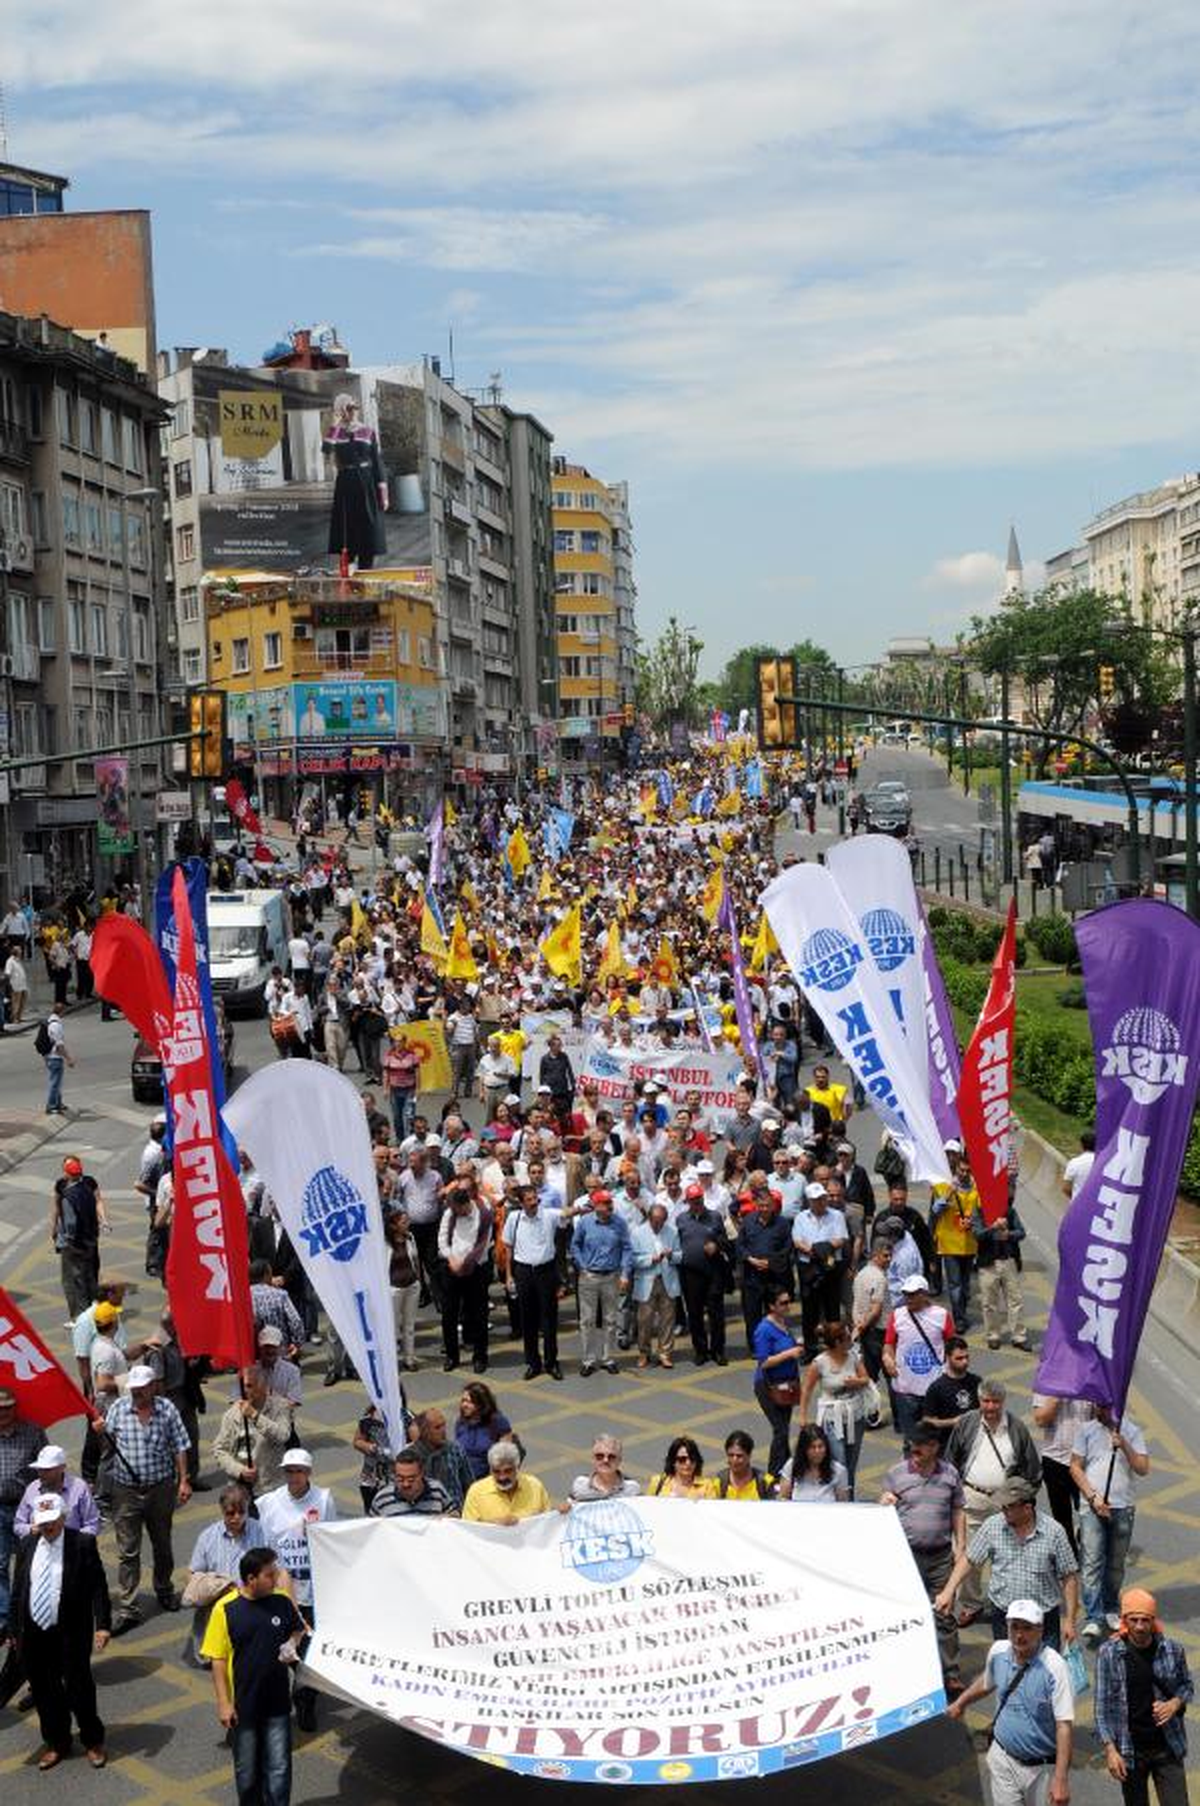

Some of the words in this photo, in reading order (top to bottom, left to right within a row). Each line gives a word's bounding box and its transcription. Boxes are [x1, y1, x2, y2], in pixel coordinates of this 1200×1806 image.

[223, 401, 278, 421] SRM
[560, 1529, 656, 1569] KESK
[464, 1594, 552, 1619] GREVLİ
[559, 1586, 635, 1612] TOPLU
[432, 1622, 530, 1649] İNSANCA
[538, 1605, 667, 1639] YAŞAYACAK
[745, 1615, 926, 1674] ETKİLENMESİN
[371, 1673, 448, 1697] KADIN
[611, 1709, 661, 1721] SON
